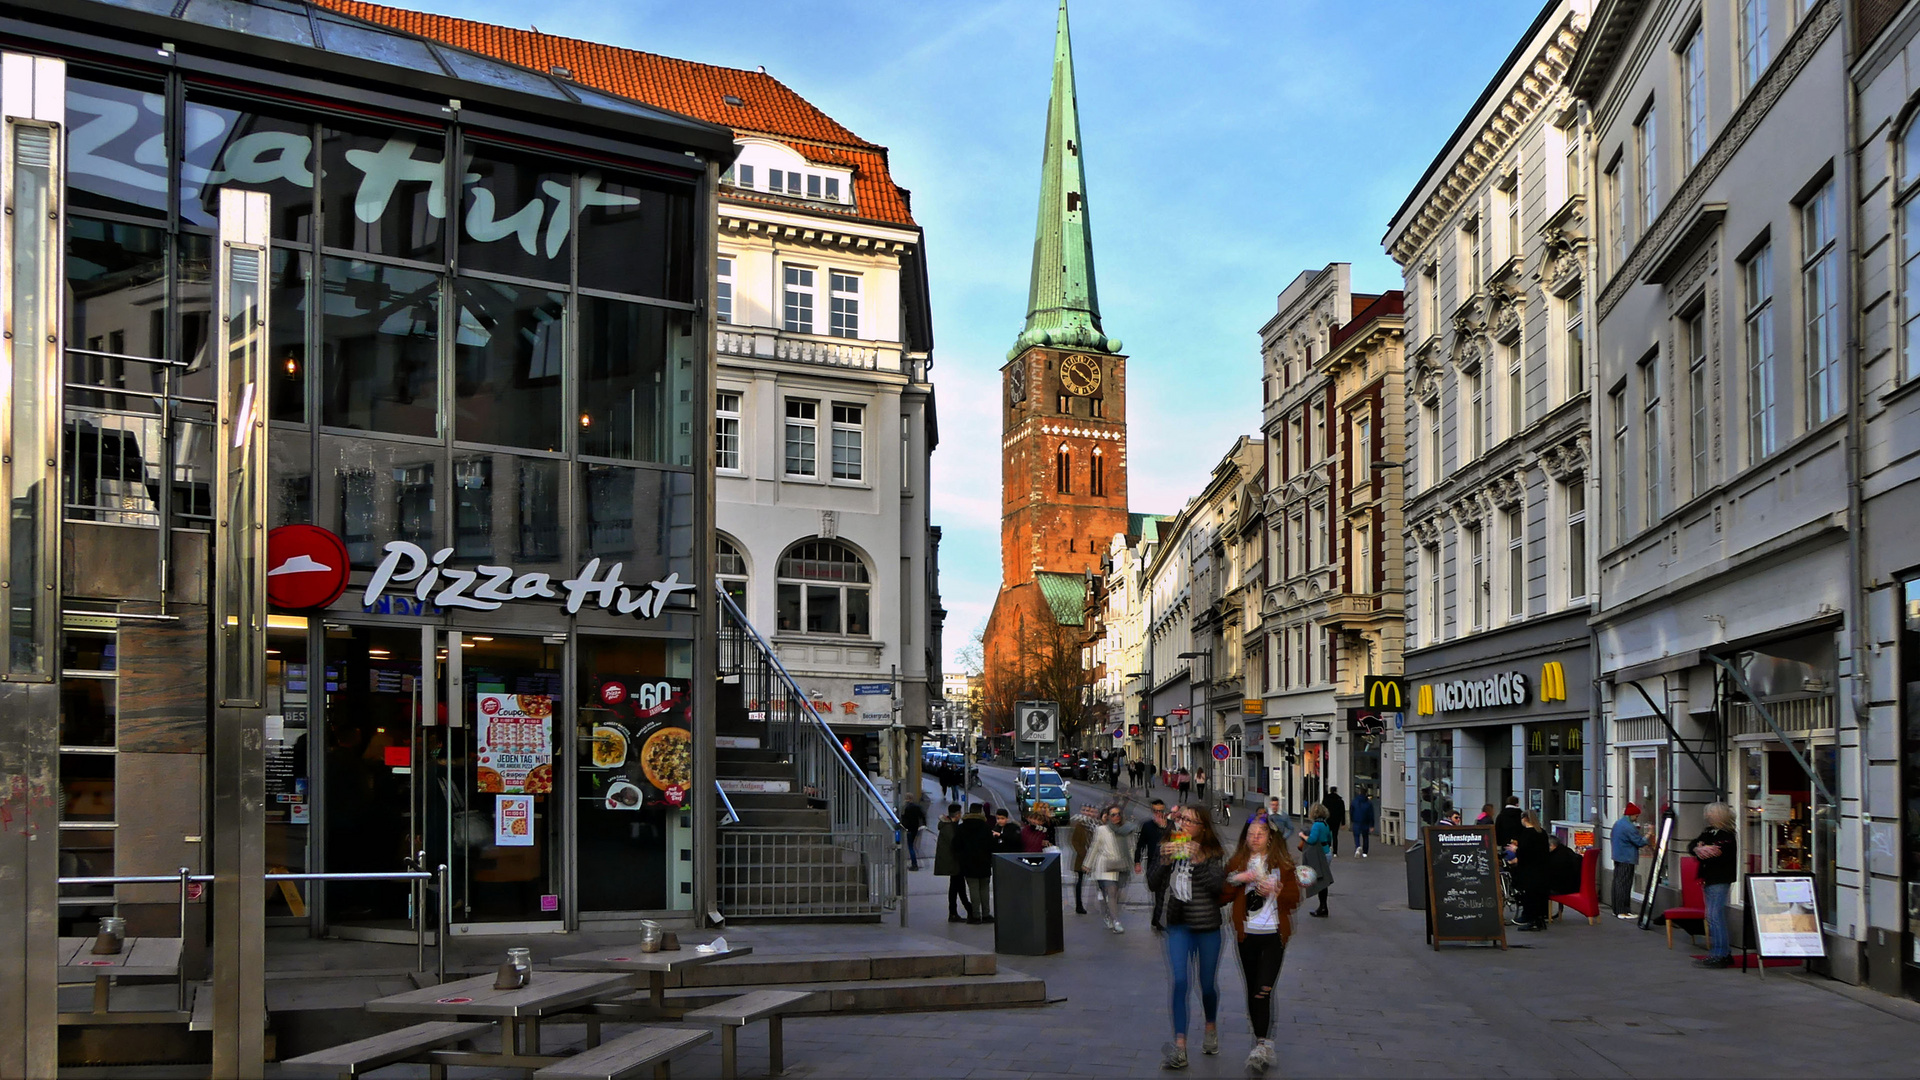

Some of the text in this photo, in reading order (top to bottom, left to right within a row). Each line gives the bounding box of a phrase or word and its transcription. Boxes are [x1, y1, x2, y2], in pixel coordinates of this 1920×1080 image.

[345, 138, 641, 260] Hut
[363, 541, 697, 618] Pizza Hut
[640, 681, 672, 713] 60
[1434, 671, 1527, 713] McDonald's
[285, 712, 307, 721] BES
[497, 754, 519, 763] JEDEN
[520, 755, 533, 763] TAG
[1438, 833, 1482, 842] Weihenstephan
[1451, 854, 1474, 864] 50%
